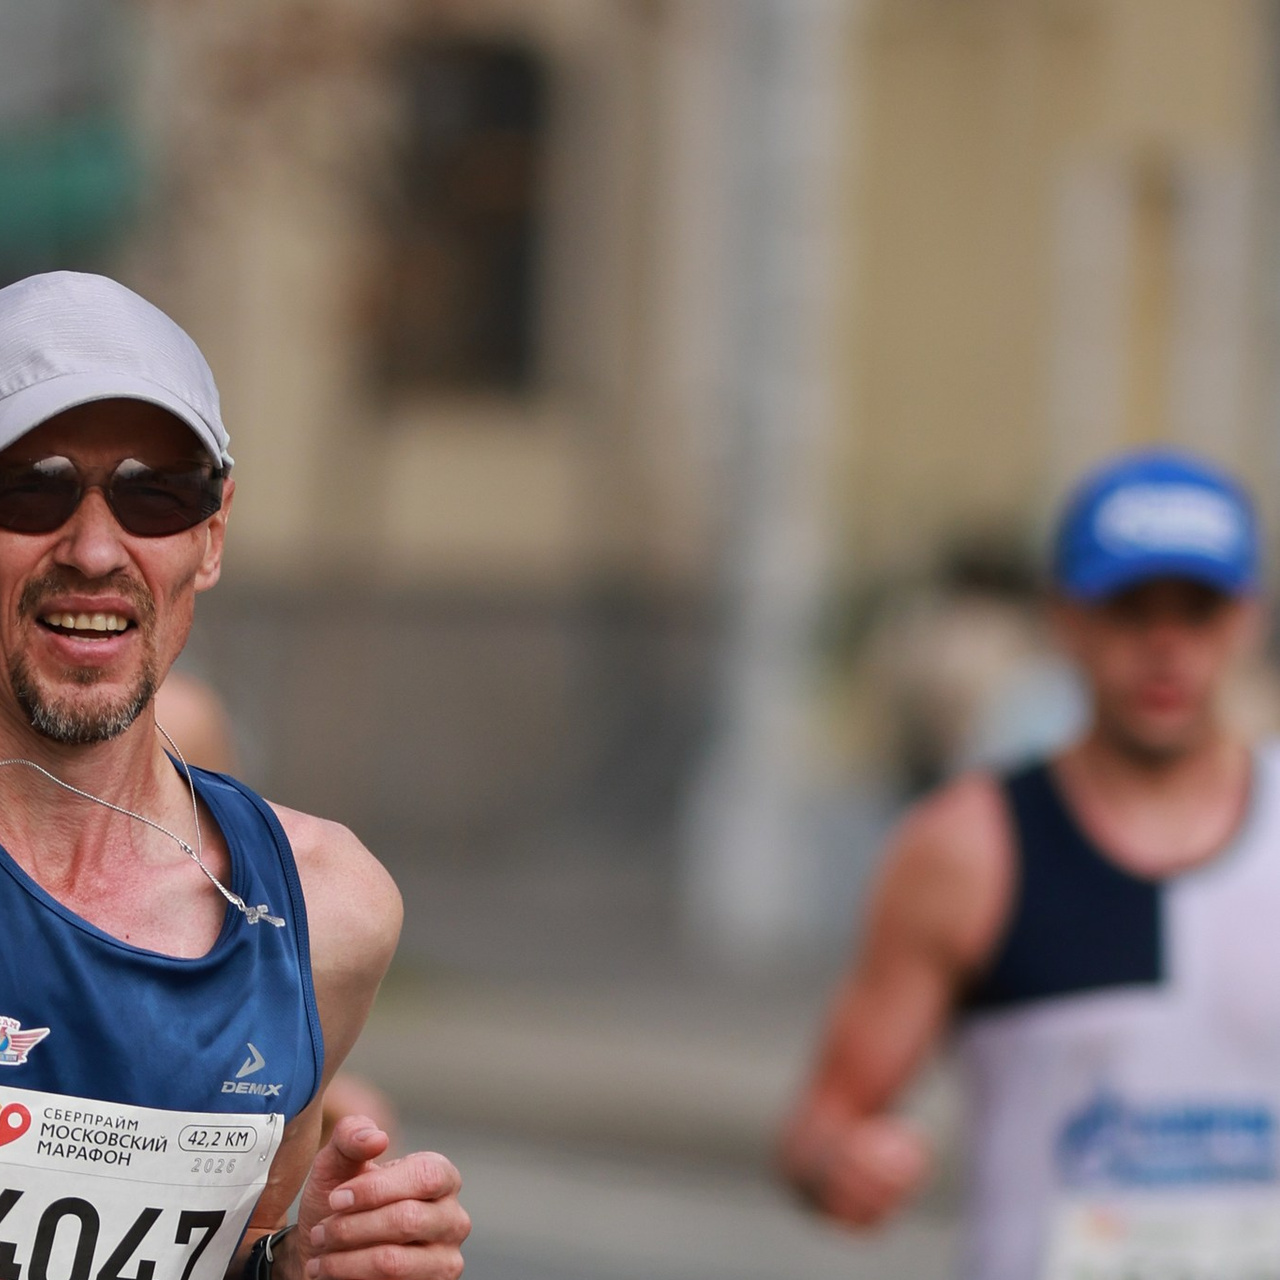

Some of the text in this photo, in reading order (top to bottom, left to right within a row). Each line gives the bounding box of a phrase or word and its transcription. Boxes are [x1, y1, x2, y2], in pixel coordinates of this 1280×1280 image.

[221, 1081, 283, 1096] DEMIX
[43, 1107, 139, 1131] СБЕРПРАЙМ
[39, 1122, 168, 1153] МОСКОВСКИЙ
[187, 1130, 220, 1148] 42,2
[37, 1140, 132, 1167] МАРАФОН
[190, 1157, 237, 1174] 2026
